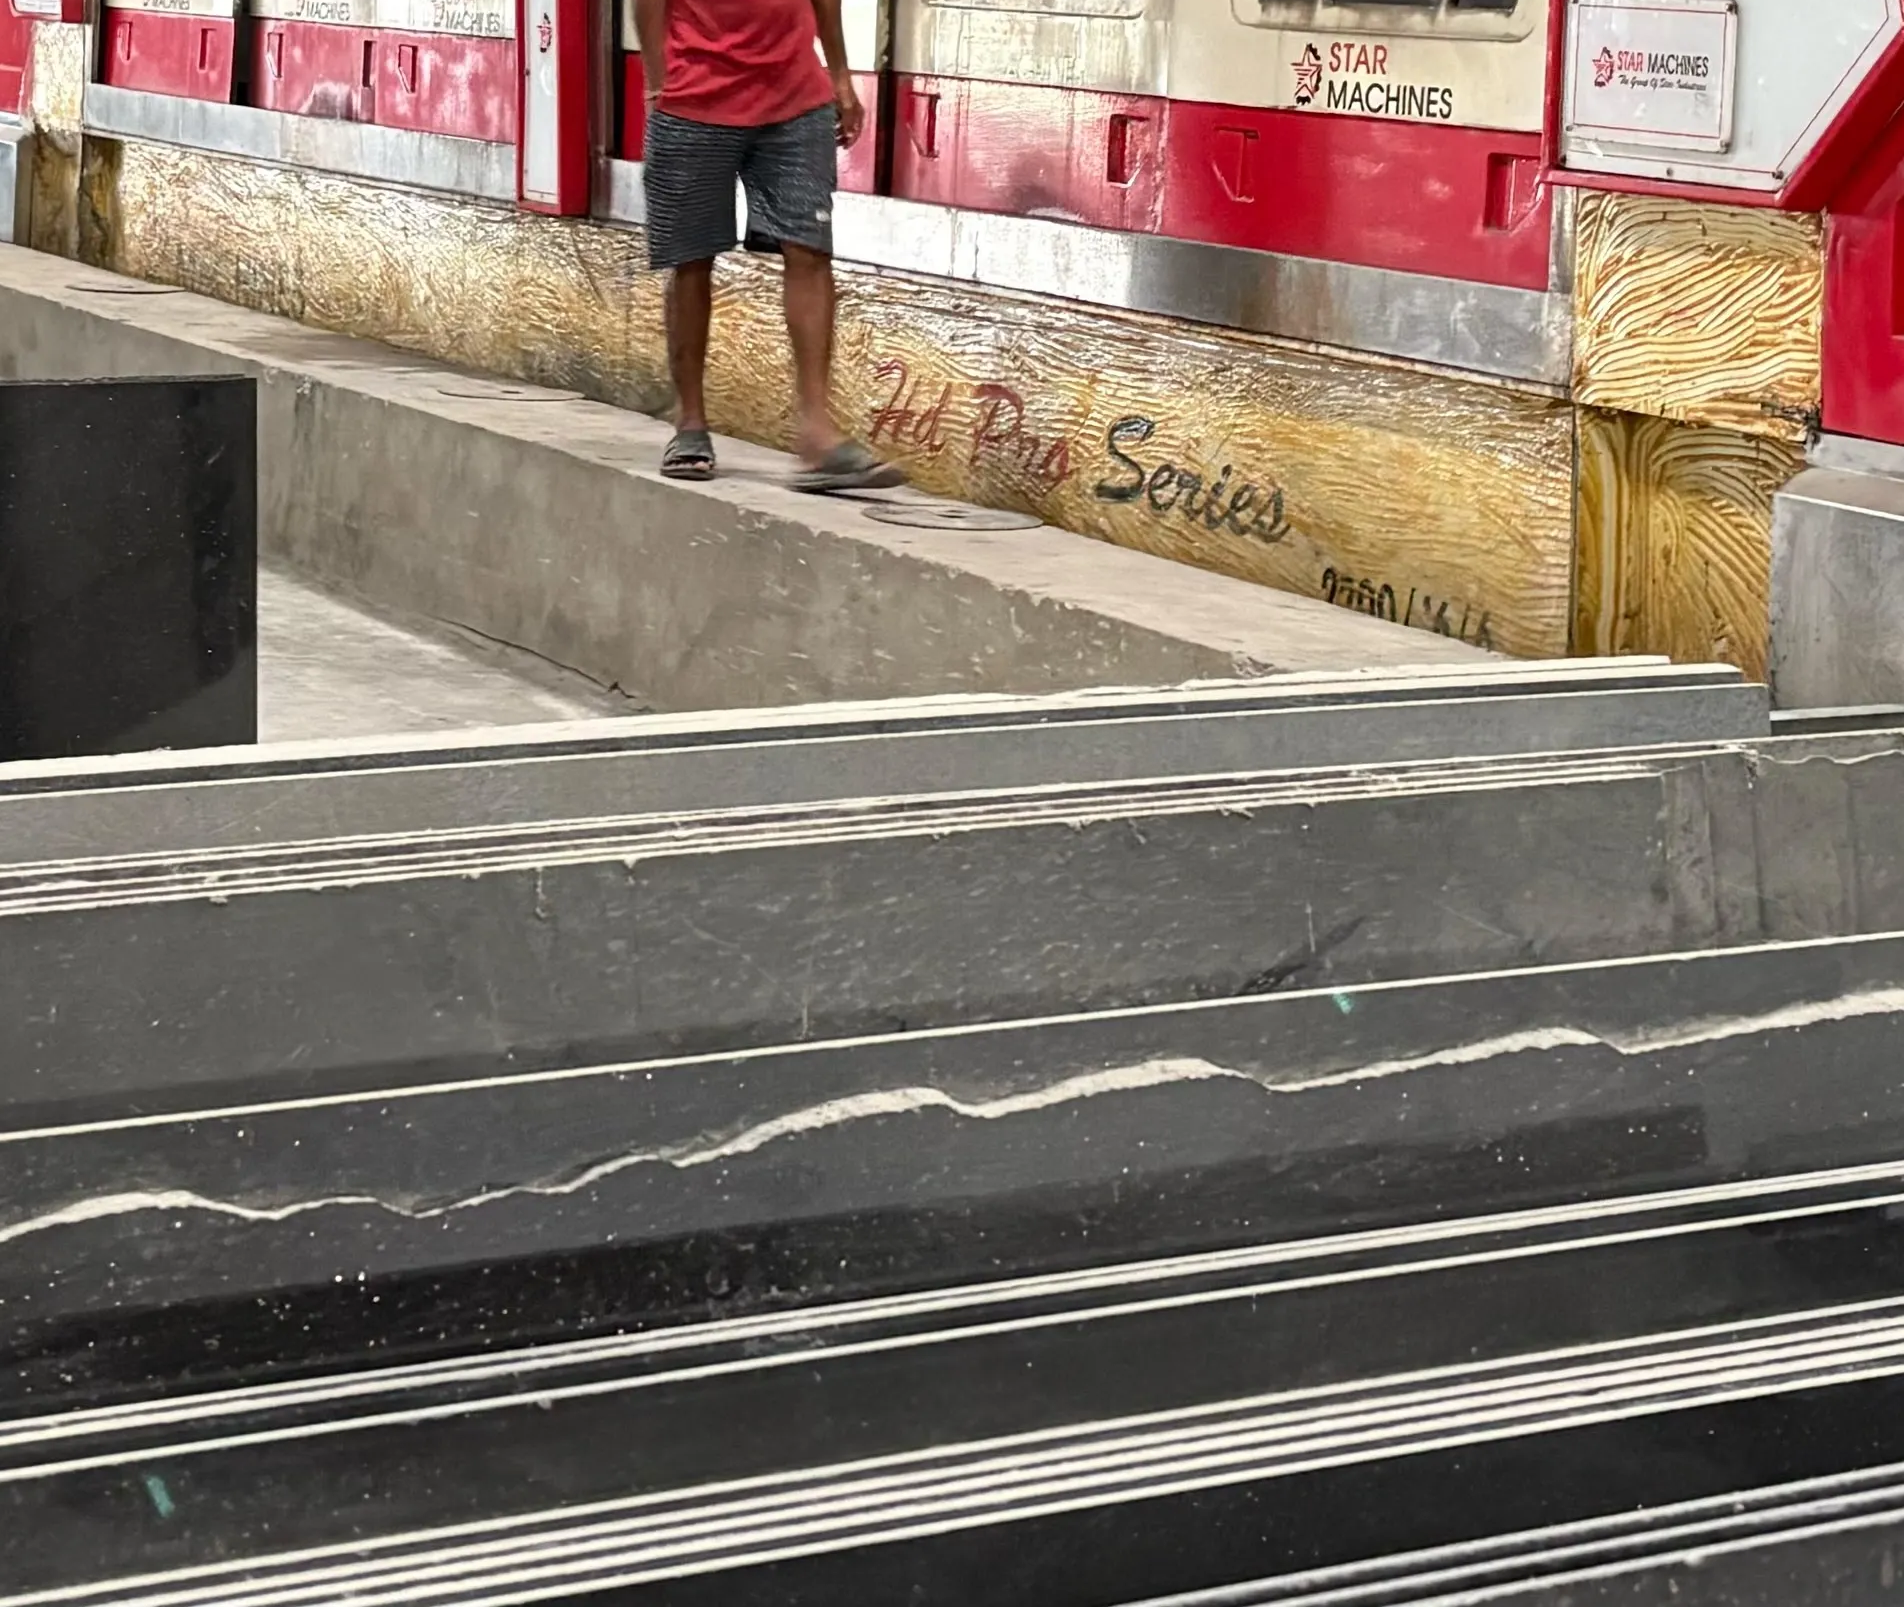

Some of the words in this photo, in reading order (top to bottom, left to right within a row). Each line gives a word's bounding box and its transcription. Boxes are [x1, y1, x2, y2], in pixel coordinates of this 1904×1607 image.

[1329, 41, 1388, 75] STAR
[1617, 50, 1644, 72] STAR
[1647, 53, 1709, 78] MACHINES
[1327, 80, 1453, 120] MACHINES
[1094, 413, 1292, 543] Series
